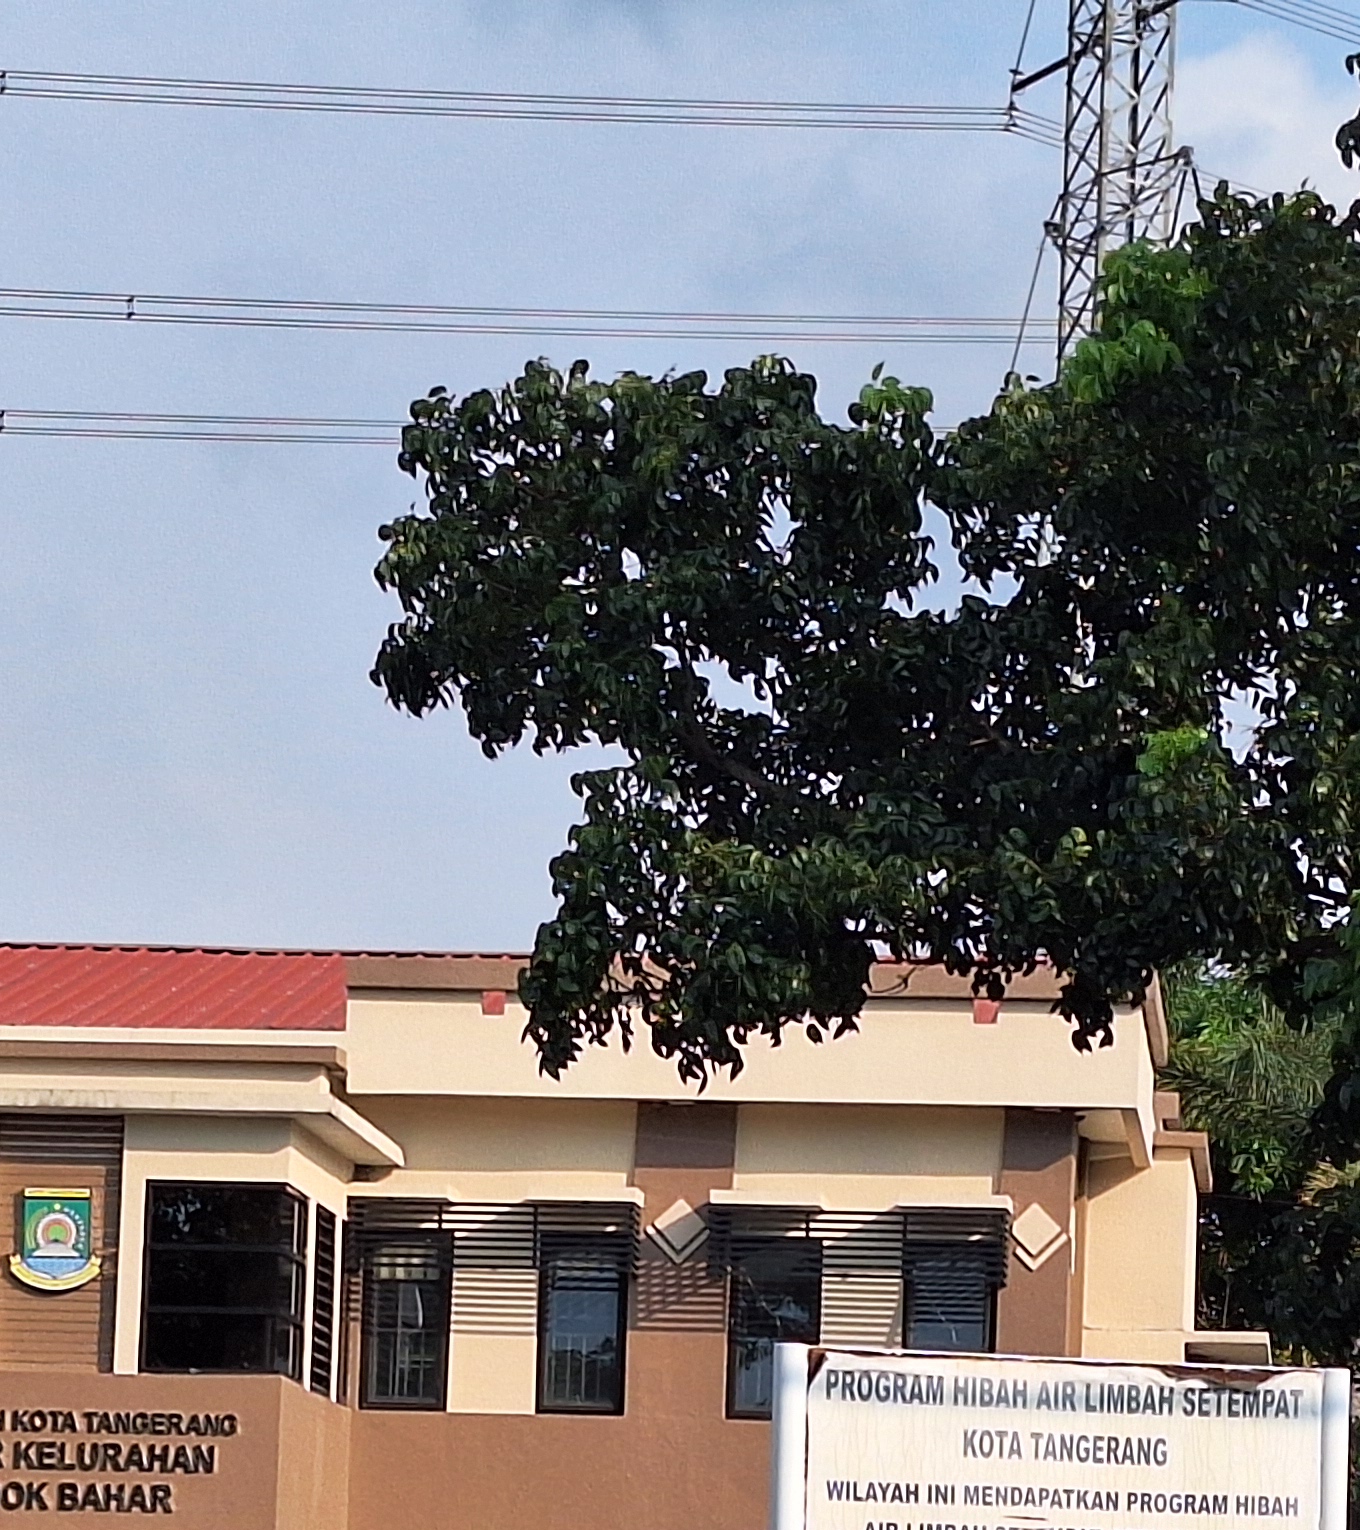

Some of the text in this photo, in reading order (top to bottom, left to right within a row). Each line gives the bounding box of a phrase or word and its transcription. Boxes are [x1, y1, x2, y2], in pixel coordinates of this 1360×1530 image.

[825, 1369, 1304, 1420] PROGRAM HIBAH AIR LIMBAH SETEMPAT
[11, 1410, 78, 1434] KOTA
[82, 1411, 239, 1437] TANGERANG
[11, 1441, 216, 1474] KELURAHAN
[963, 1428, 1168, 1467] KOTA TANGERANG
[56, 1481, 174, 1514] BAHAR
[827, 1479, 1299, 1517] WILAYAH INI MENDAPATKAN PROGRAM HIBAH
